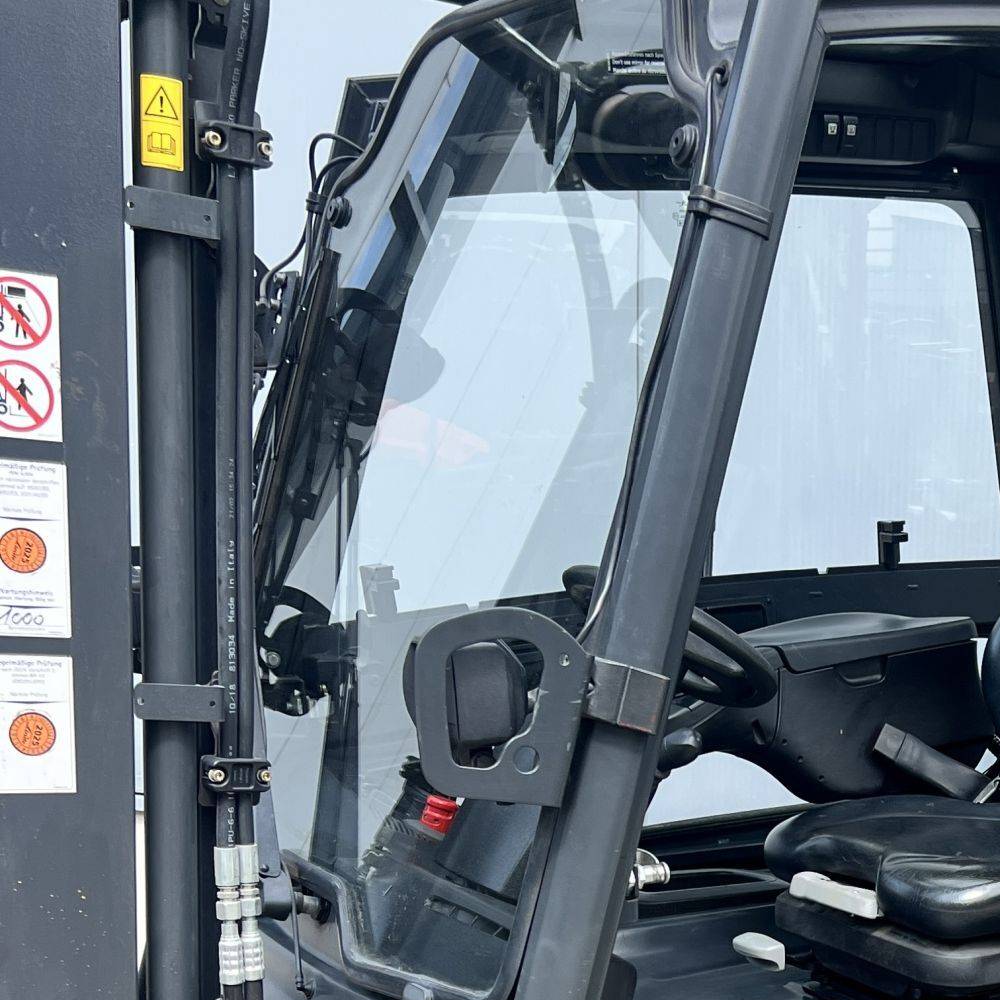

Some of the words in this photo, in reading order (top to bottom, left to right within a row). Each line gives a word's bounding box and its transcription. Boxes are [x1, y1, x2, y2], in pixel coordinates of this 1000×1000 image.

[229, 67, 241, 108] PARKER
[236, 1, 251, 62] NO-SKIVE
[21, 541, 34, 563] 2025
[227, 540, 235, 571] Italy
[229, 578, 234, 589] in
[0, 606, 44, 626] 1000
[228, 634, 236, 672] 813034
[32, 725, 43, 746] 2025
